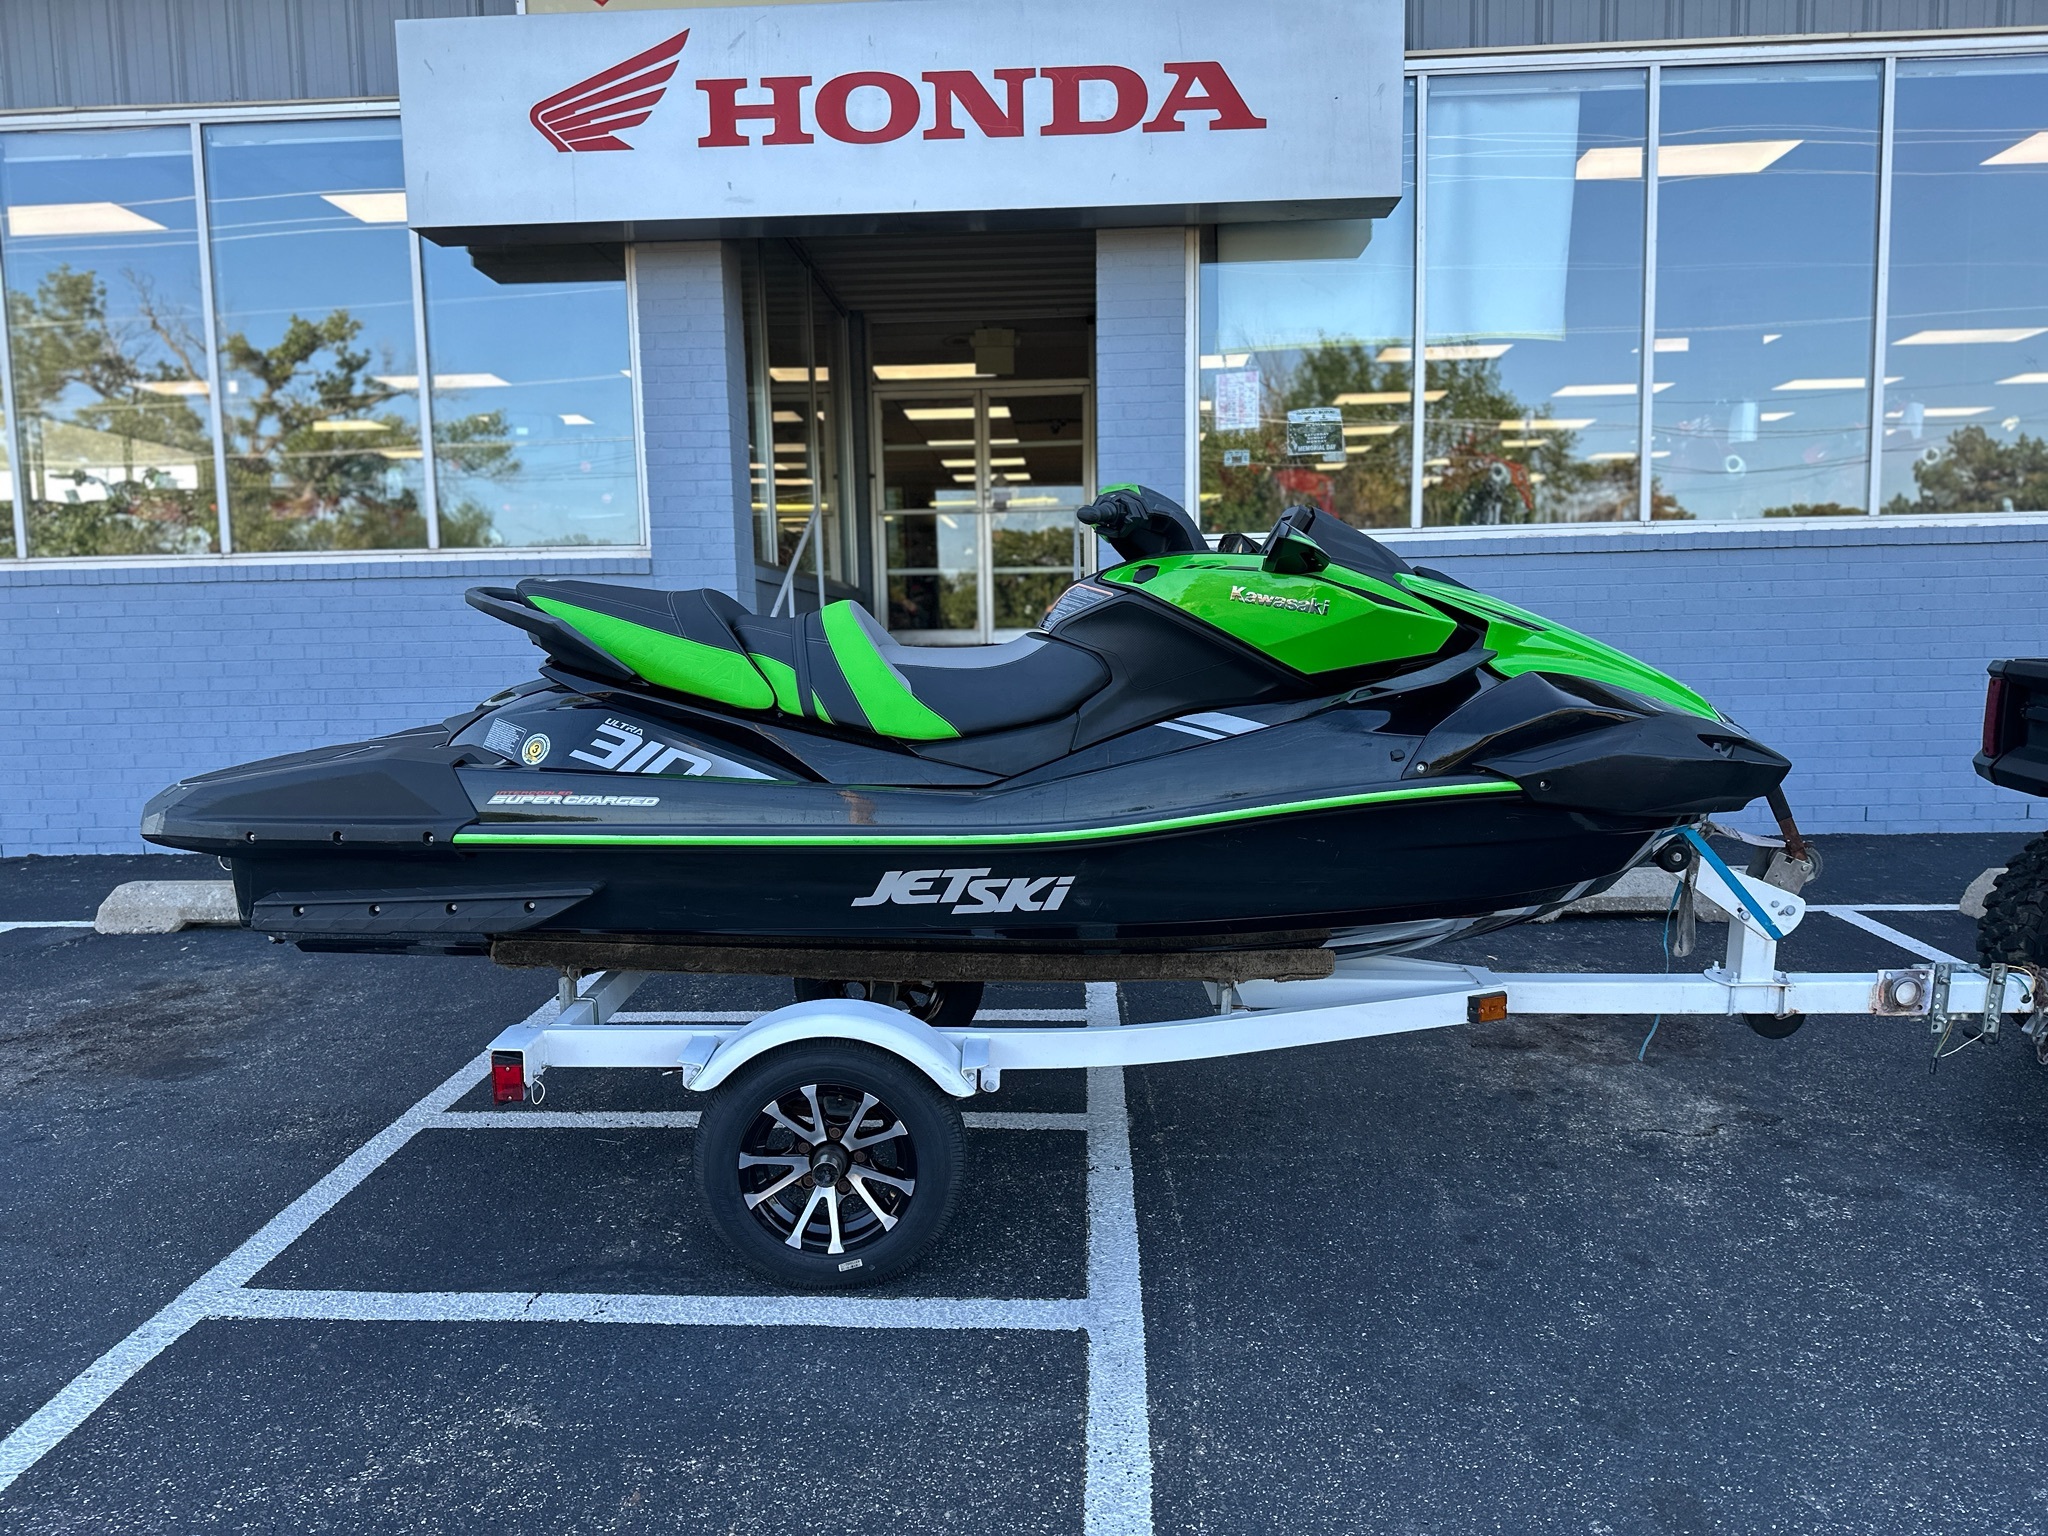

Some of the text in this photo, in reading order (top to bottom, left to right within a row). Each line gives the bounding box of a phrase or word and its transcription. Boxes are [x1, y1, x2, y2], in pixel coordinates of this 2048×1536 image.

[695, 61, 1267, 148] HONDA
[1230, 585, 1330, 616] Kawasaki
[604, 717, 644, 736] ULTRA
[532, 744, 540, 754] 3
